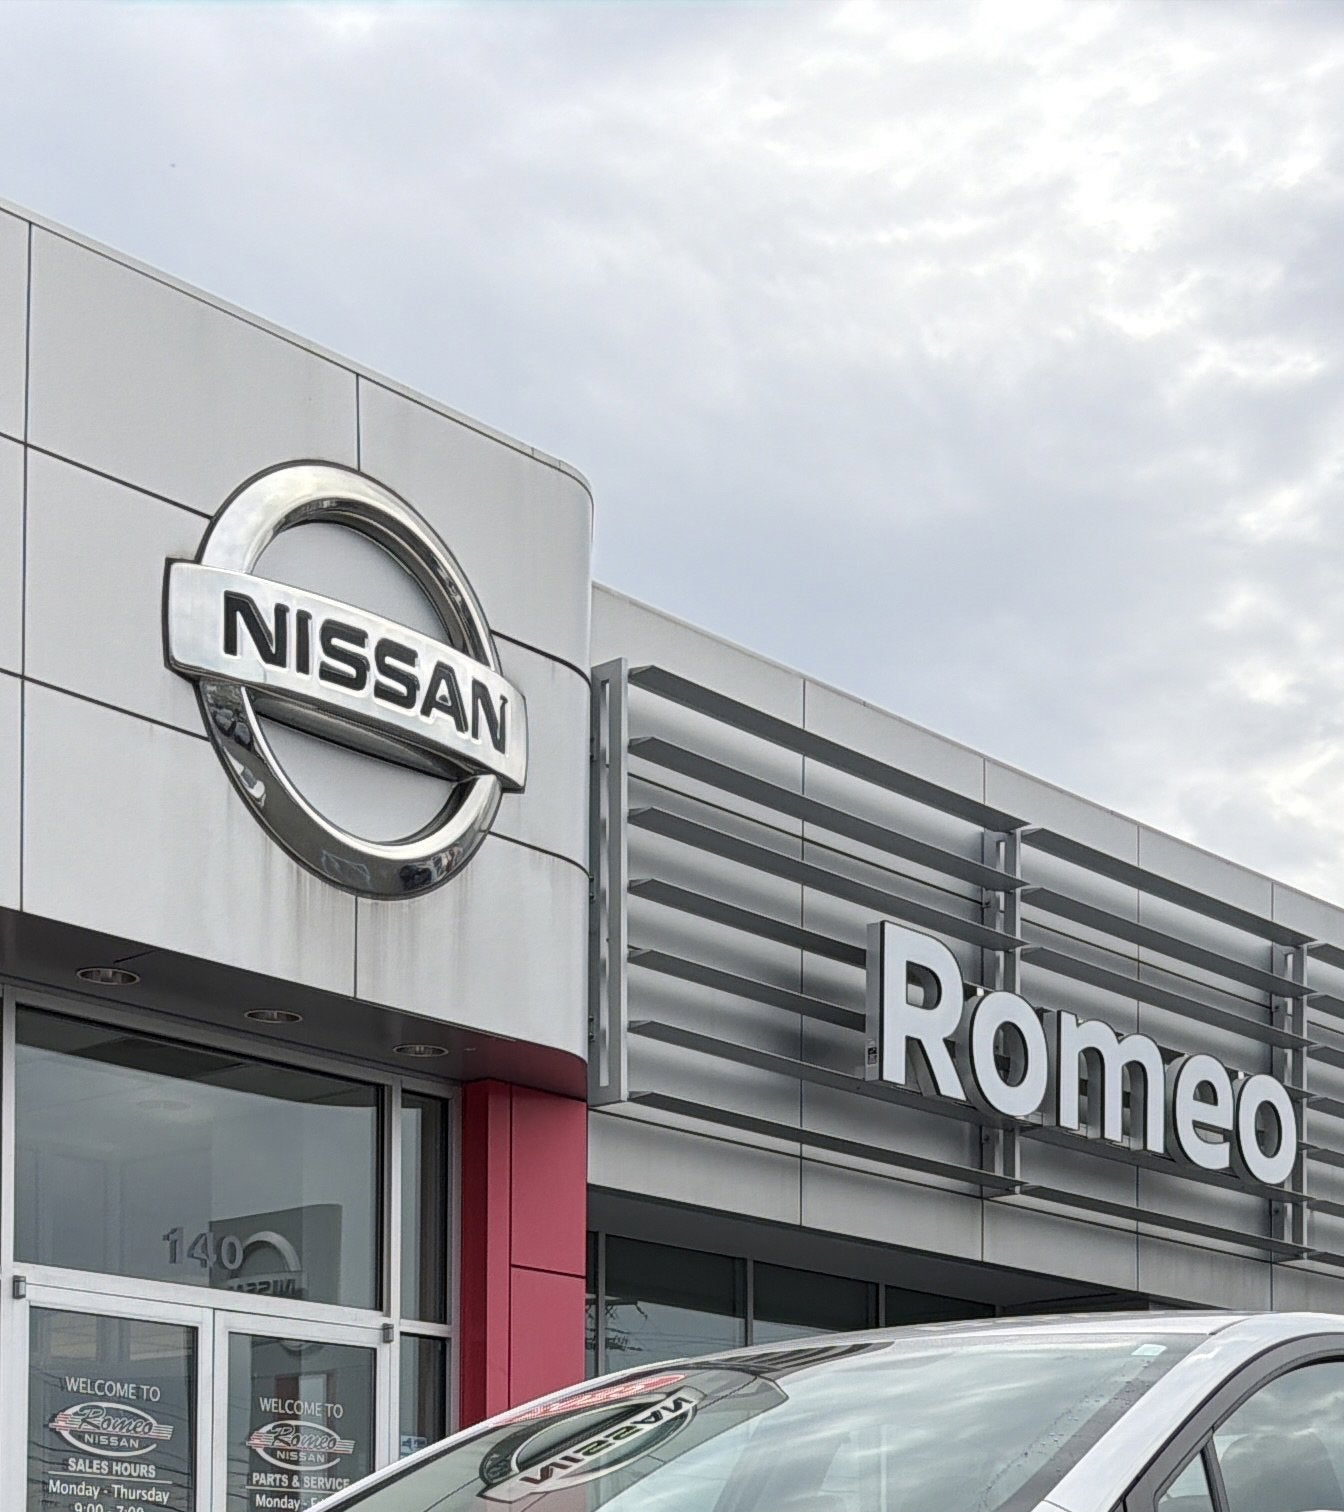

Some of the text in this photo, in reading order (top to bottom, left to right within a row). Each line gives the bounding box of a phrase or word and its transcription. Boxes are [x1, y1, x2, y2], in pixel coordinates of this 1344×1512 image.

[223, 590, 509, 754] NISSAN
[874, 920, 1297, 1185] Romeo
[162, 1227, 244, 1271] 140
[65, 1376, 161, 1401] WELCOME TO
[77, 1404, 154, 1435] Romeo
[259, 1397, 344, 1419] WELCOME TO
[84, 1434, 140, 1449] NISSAN
[271, 1422, 337, 1450] Romeo
[68, 1457, 156, 1478] SALES HOURS
[276, 1450, 325, 1462] NISSAN
[48, 1479, 100, 1500] Monday
[111, 1484, 170, 1505] Thursday
[252, 1472, 289, 1486] PARTS
[291, 1475, 300, 1488] &
[256, 1494, 301, 1511] Monday
